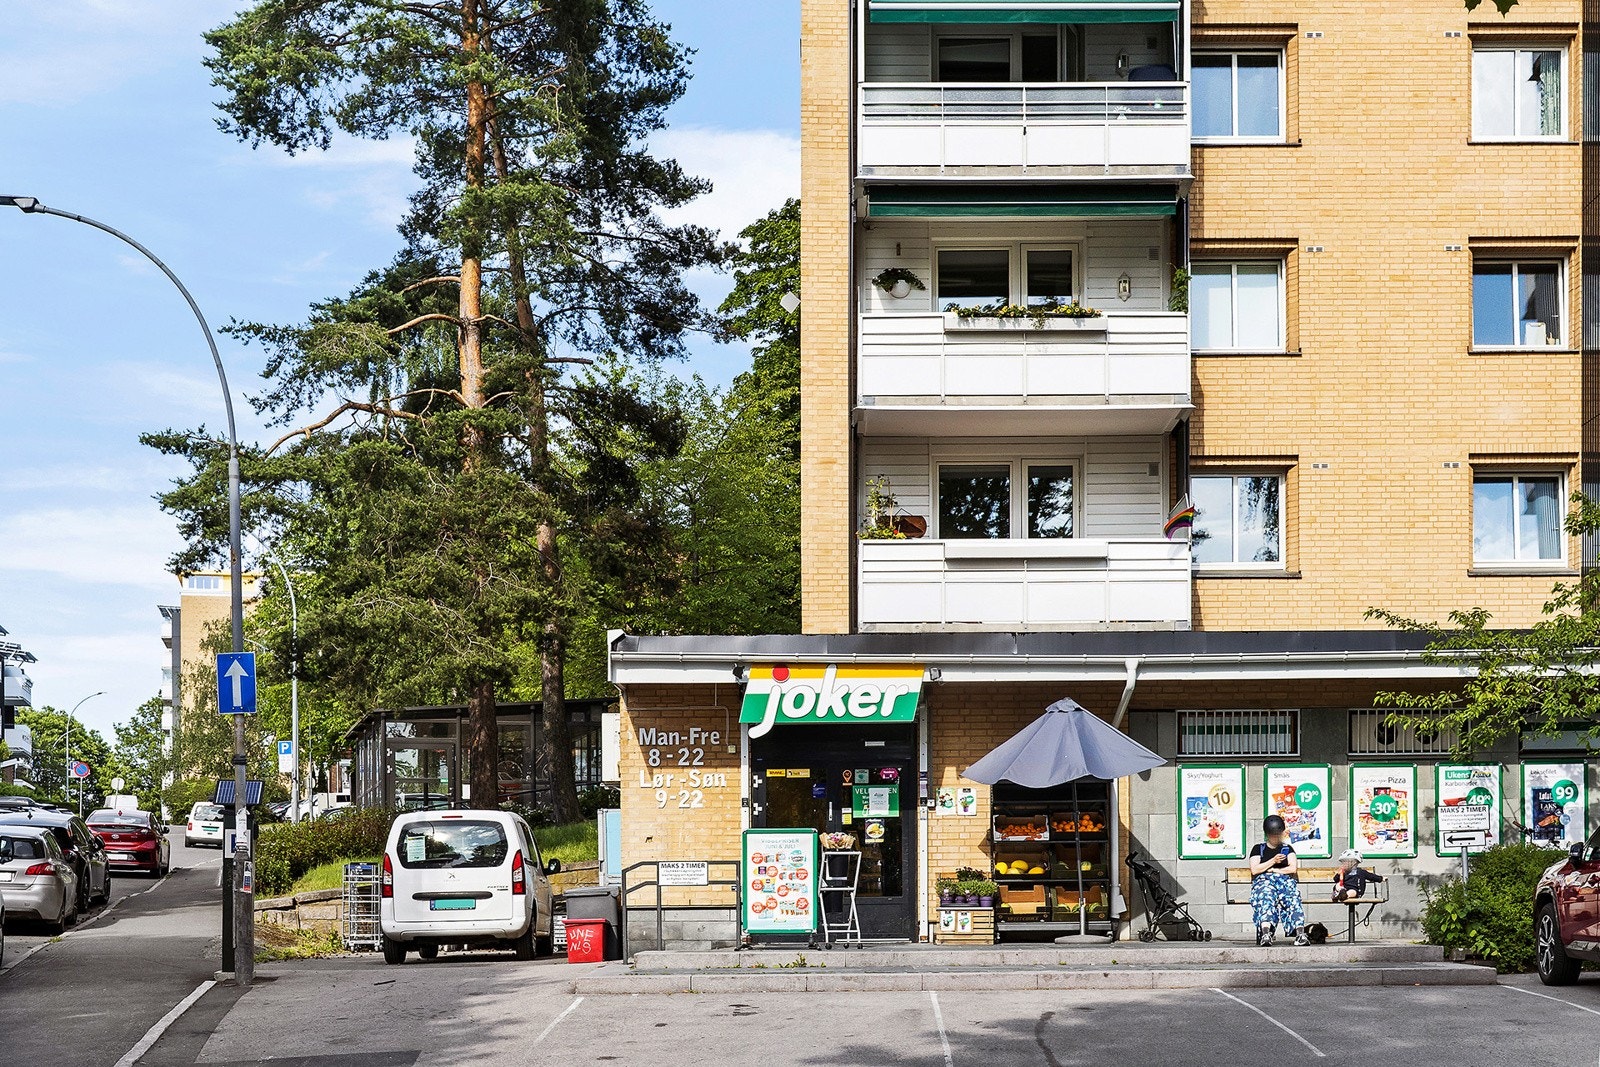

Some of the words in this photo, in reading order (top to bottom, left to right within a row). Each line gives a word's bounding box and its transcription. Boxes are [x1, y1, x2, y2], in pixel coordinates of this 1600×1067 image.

[748, 664, 910, 739] joker
[639, 727, 720, 746] Man-Fre
[281, 742, 290, 753] P
[1447, 770, 1470, 779] Ukens
[1213, 791, 1231, 806] 10
[1555, 786, 1574, 800] 99
